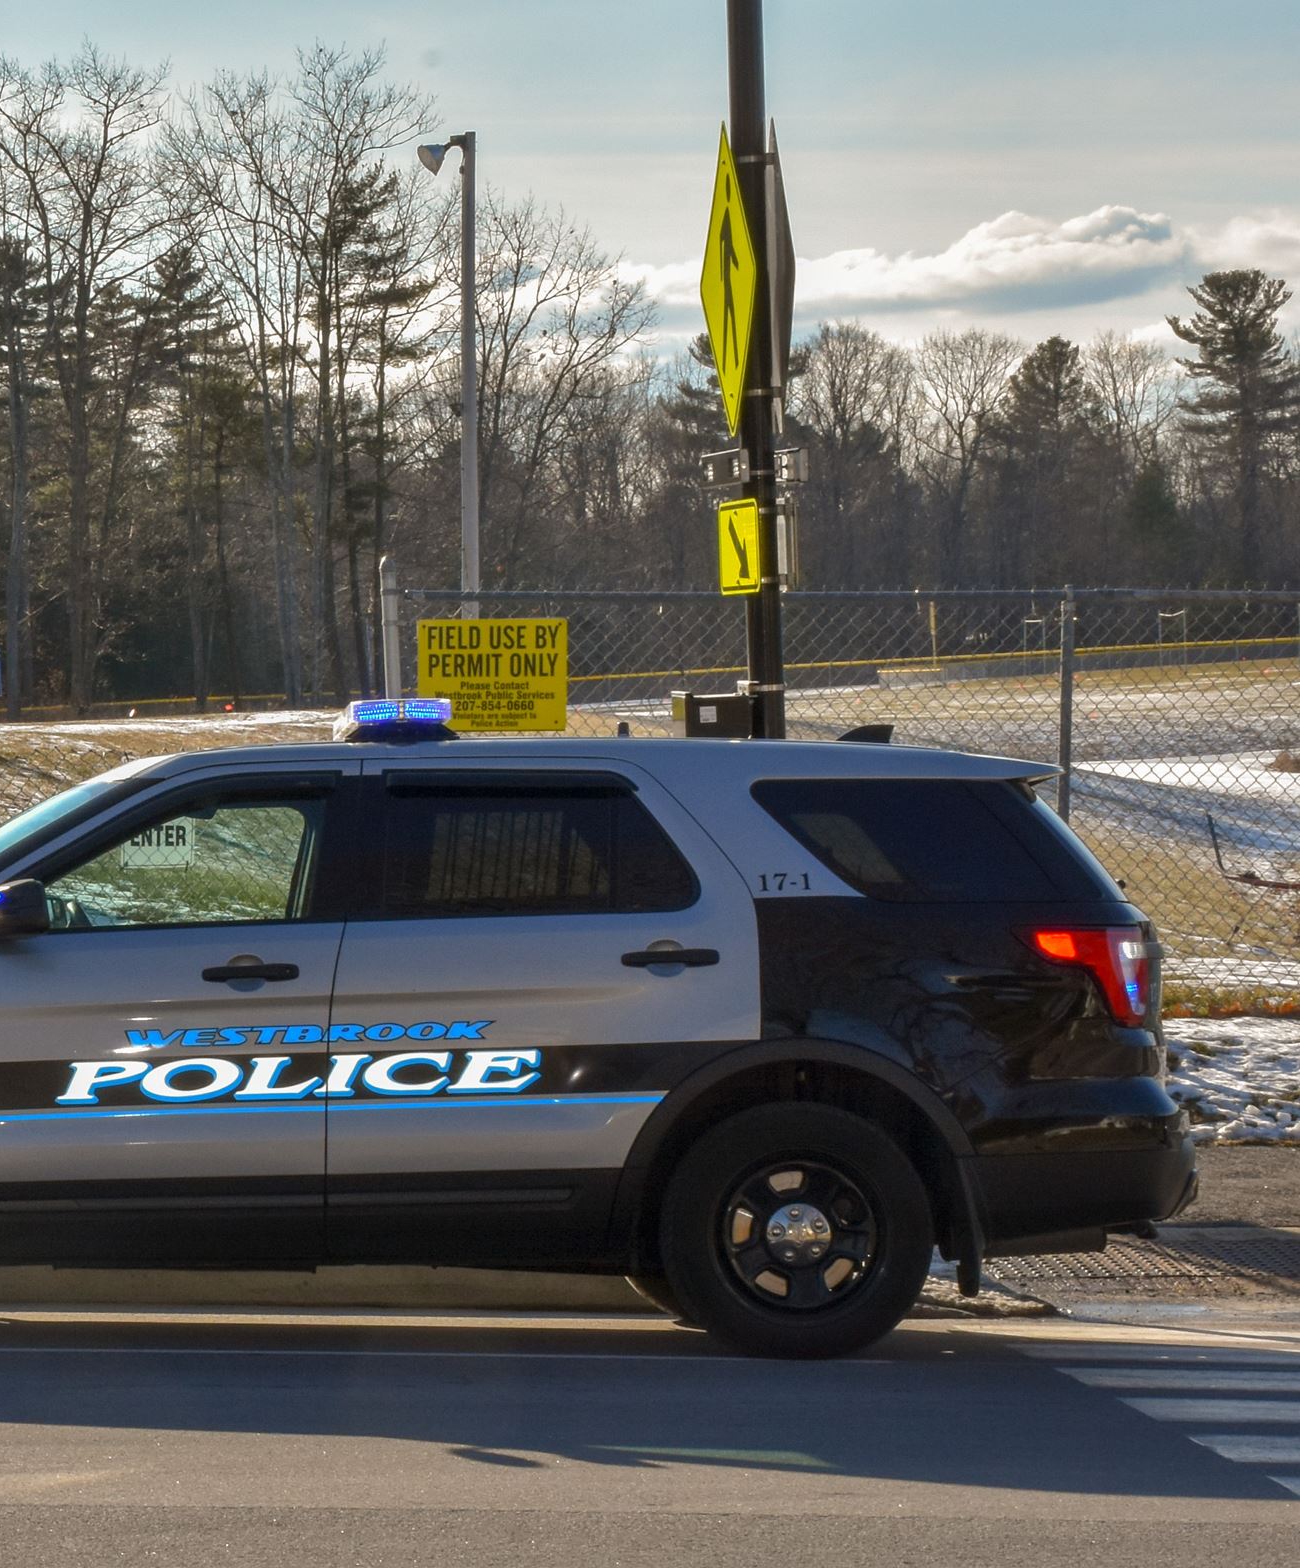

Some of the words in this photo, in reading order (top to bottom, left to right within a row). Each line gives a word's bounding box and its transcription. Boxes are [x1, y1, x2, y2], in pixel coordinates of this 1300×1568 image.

[427, 626, 481, 650] FIELD
[489, 625, 526, 649] USE
[535, 625, 560, 649] BY
[428, 653, 503, 678] PERMIT
[510, 653, 558, 677] ONLY
[460, 681, 490, 690] Please
[493, 681, 529, 690] Contact
[486, 691, 514, 700] Public
[516, 691, 555, 700] Services
[455, 700, 534, 711] 207-854-0660
[501, 712, 527, 721] subject
[758, 872, 811, 892] 17-1
[123, 1020, 497, 1048] WESTBROOK
[54, 1048, 542, 1106] POLICE
